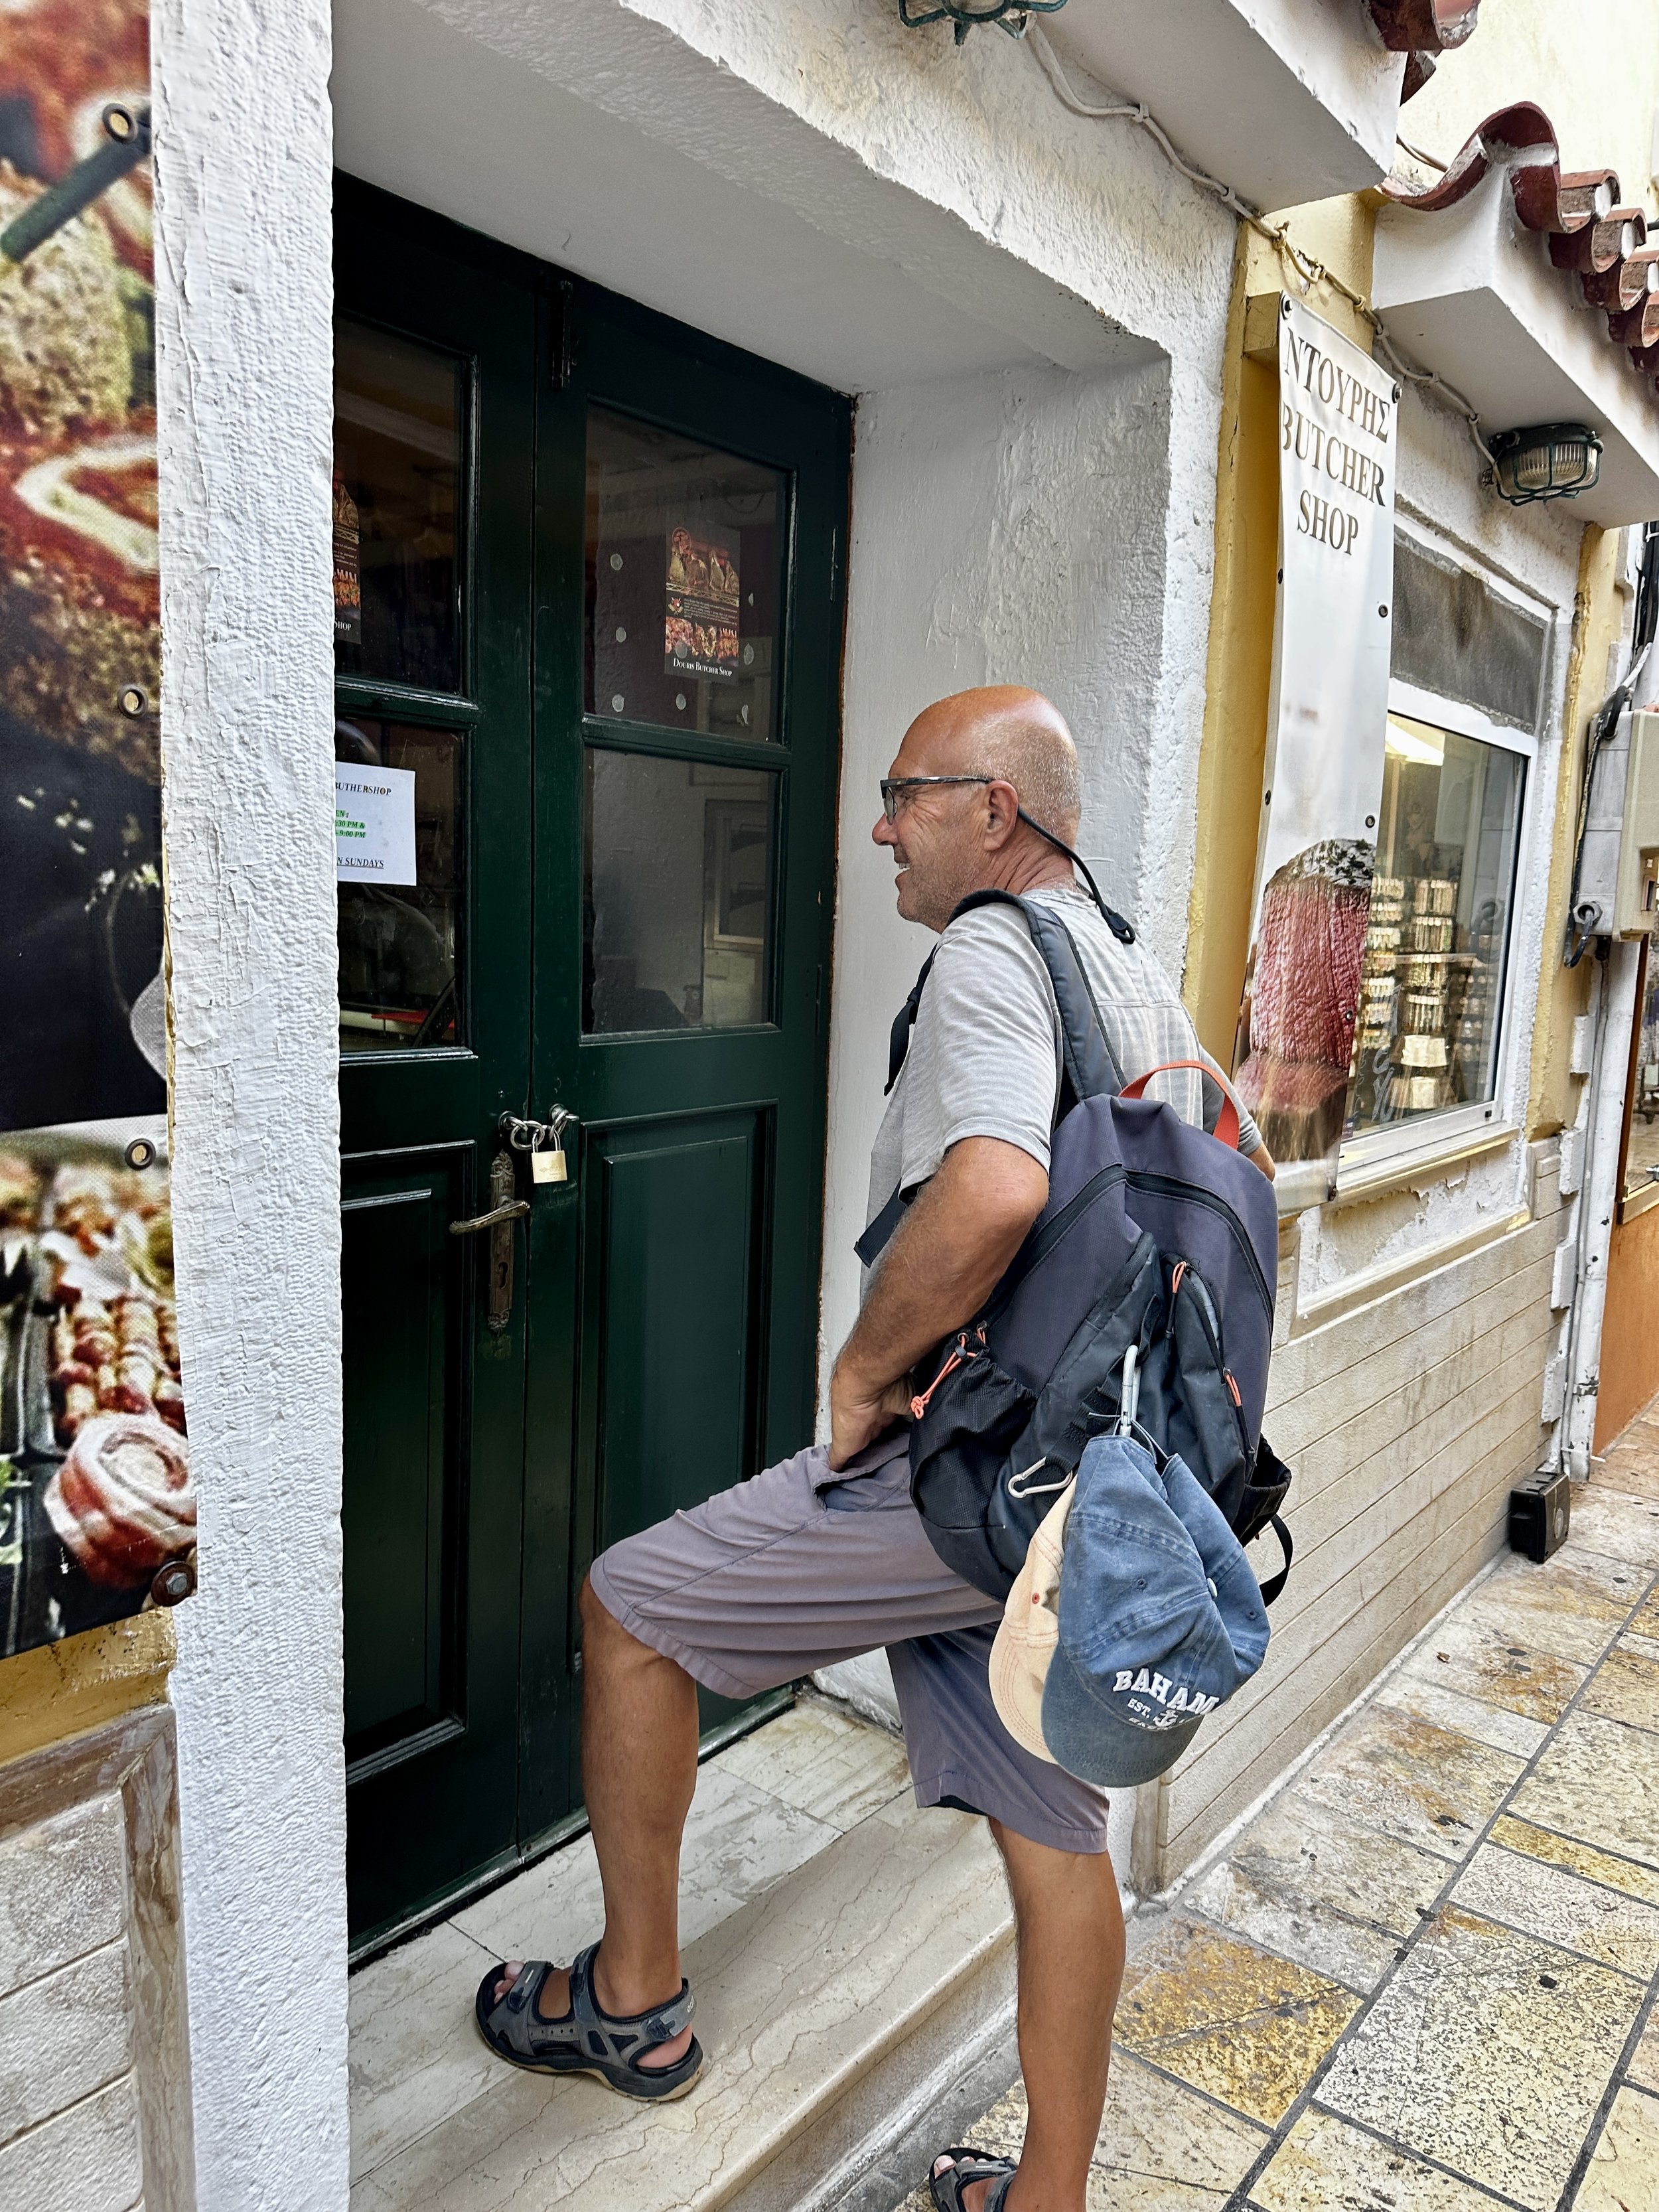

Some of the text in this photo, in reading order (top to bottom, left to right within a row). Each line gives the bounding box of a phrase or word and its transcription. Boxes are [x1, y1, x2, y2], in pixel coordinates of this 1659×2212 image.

[1285, 328, 1390, 443] ΝΤΟΥΡΗΣ
[1282, 400, 1386, 506] BUTCHER
[1297, 489, 1358, 555] SHOP
[673, 657, 733, 677] DOURIS BUTCHER SHOP
[345, 857, 384, 868] SUNDAYS
[1127, 1698, 1151, 1719] EST.
